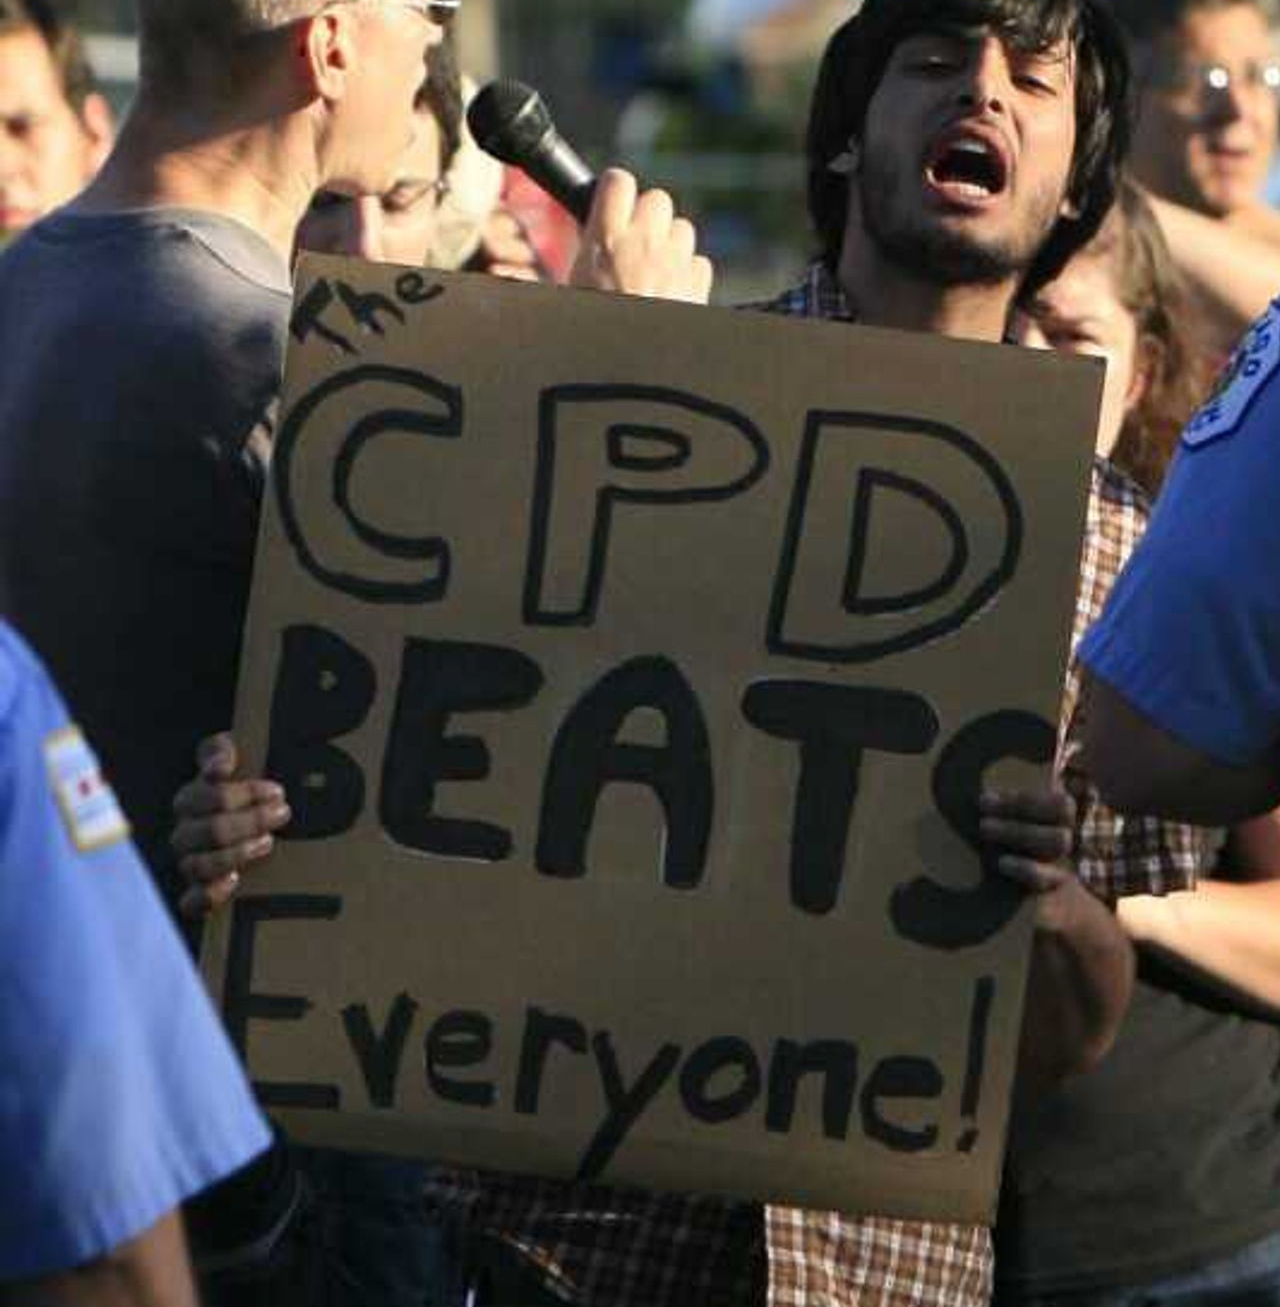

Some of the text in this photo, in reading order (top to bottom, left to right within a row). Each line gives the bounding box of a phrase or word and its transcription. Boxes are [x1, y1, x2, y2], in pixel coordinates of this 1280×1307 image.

[289, 271, 446, 356] The
[271, 363, 1024, 664] CPD
[263, 623, 1063, 949] BEATS
[223, 892, 997, 1183] Everyone!
